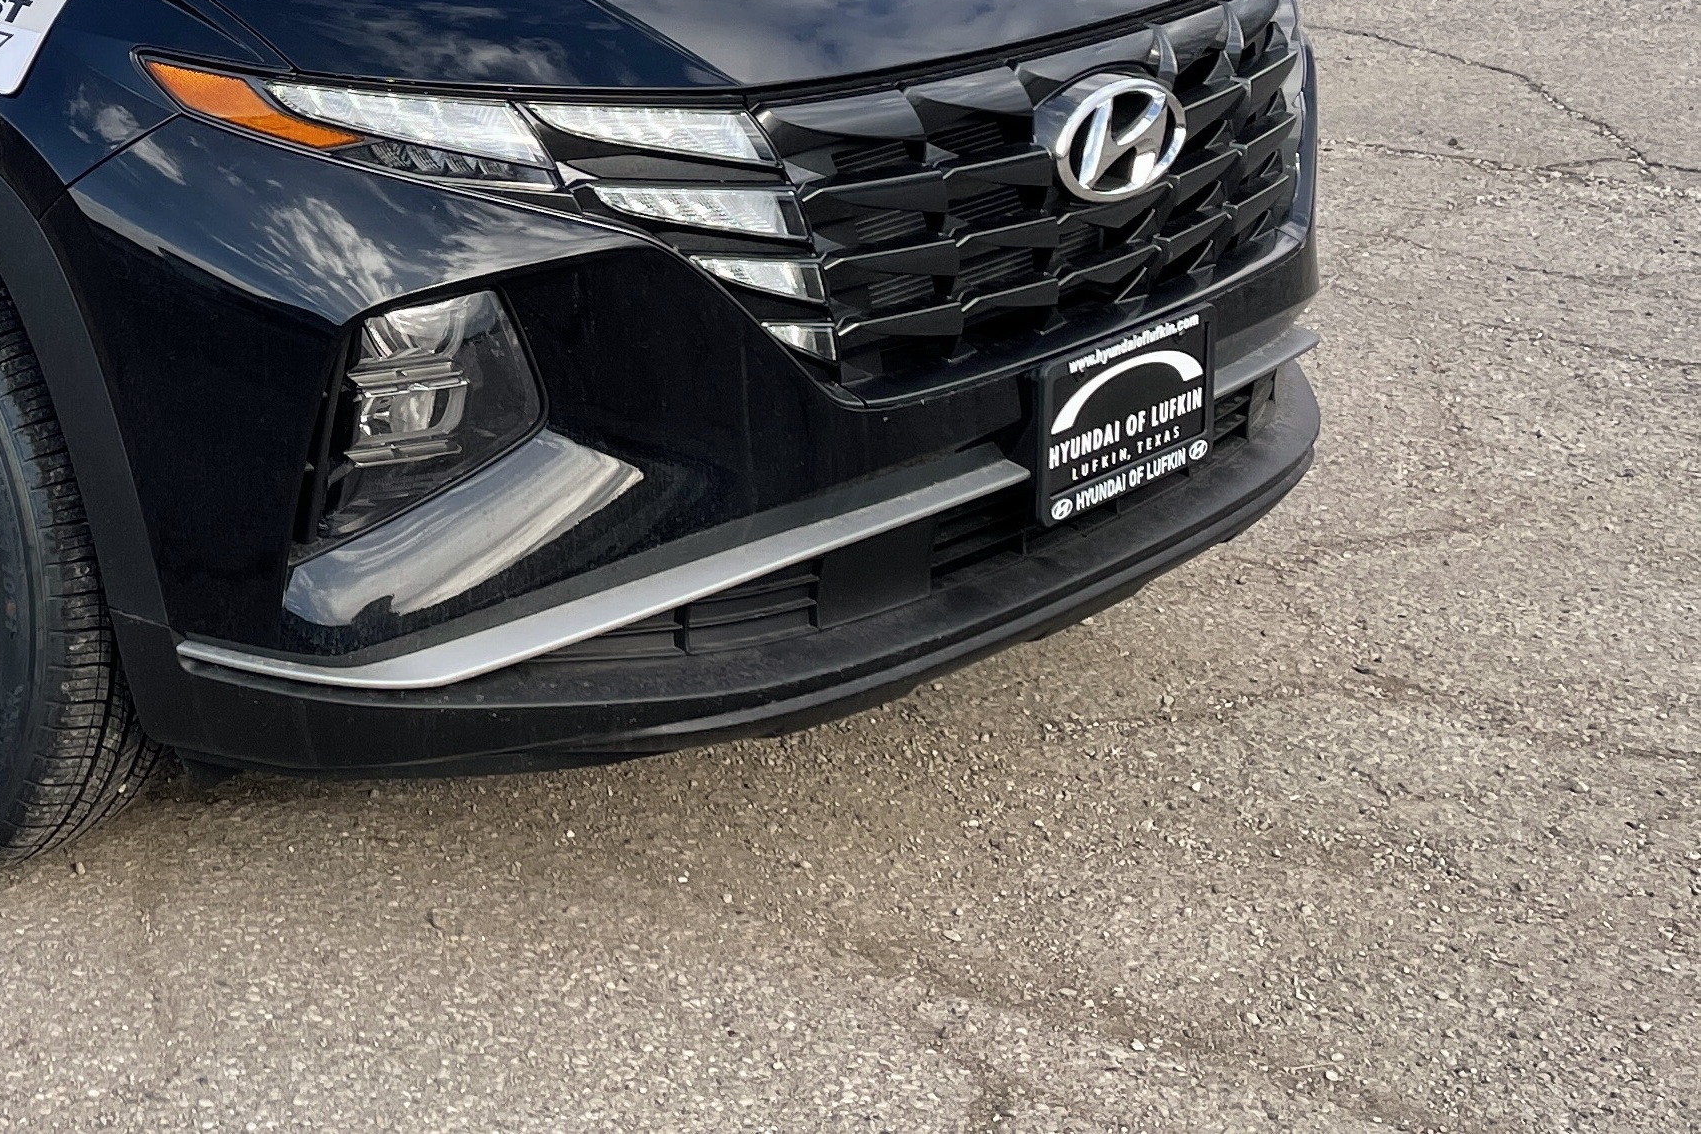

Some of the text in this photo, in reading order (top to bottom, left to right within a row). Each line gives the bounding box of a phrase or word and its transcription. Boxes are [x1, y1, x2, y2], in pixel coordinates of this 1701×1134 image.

[1068, 314, 1200, 374] www.hyundaioflufkin.com
[1048, 386, 1203, 470] HYUNDAI OF LUFKIN
[1071, 425, 1181, 481] LUFKIN, TEXAS
[1075, 447, 1187, 512] HYUNDAI OF LUFKIN
